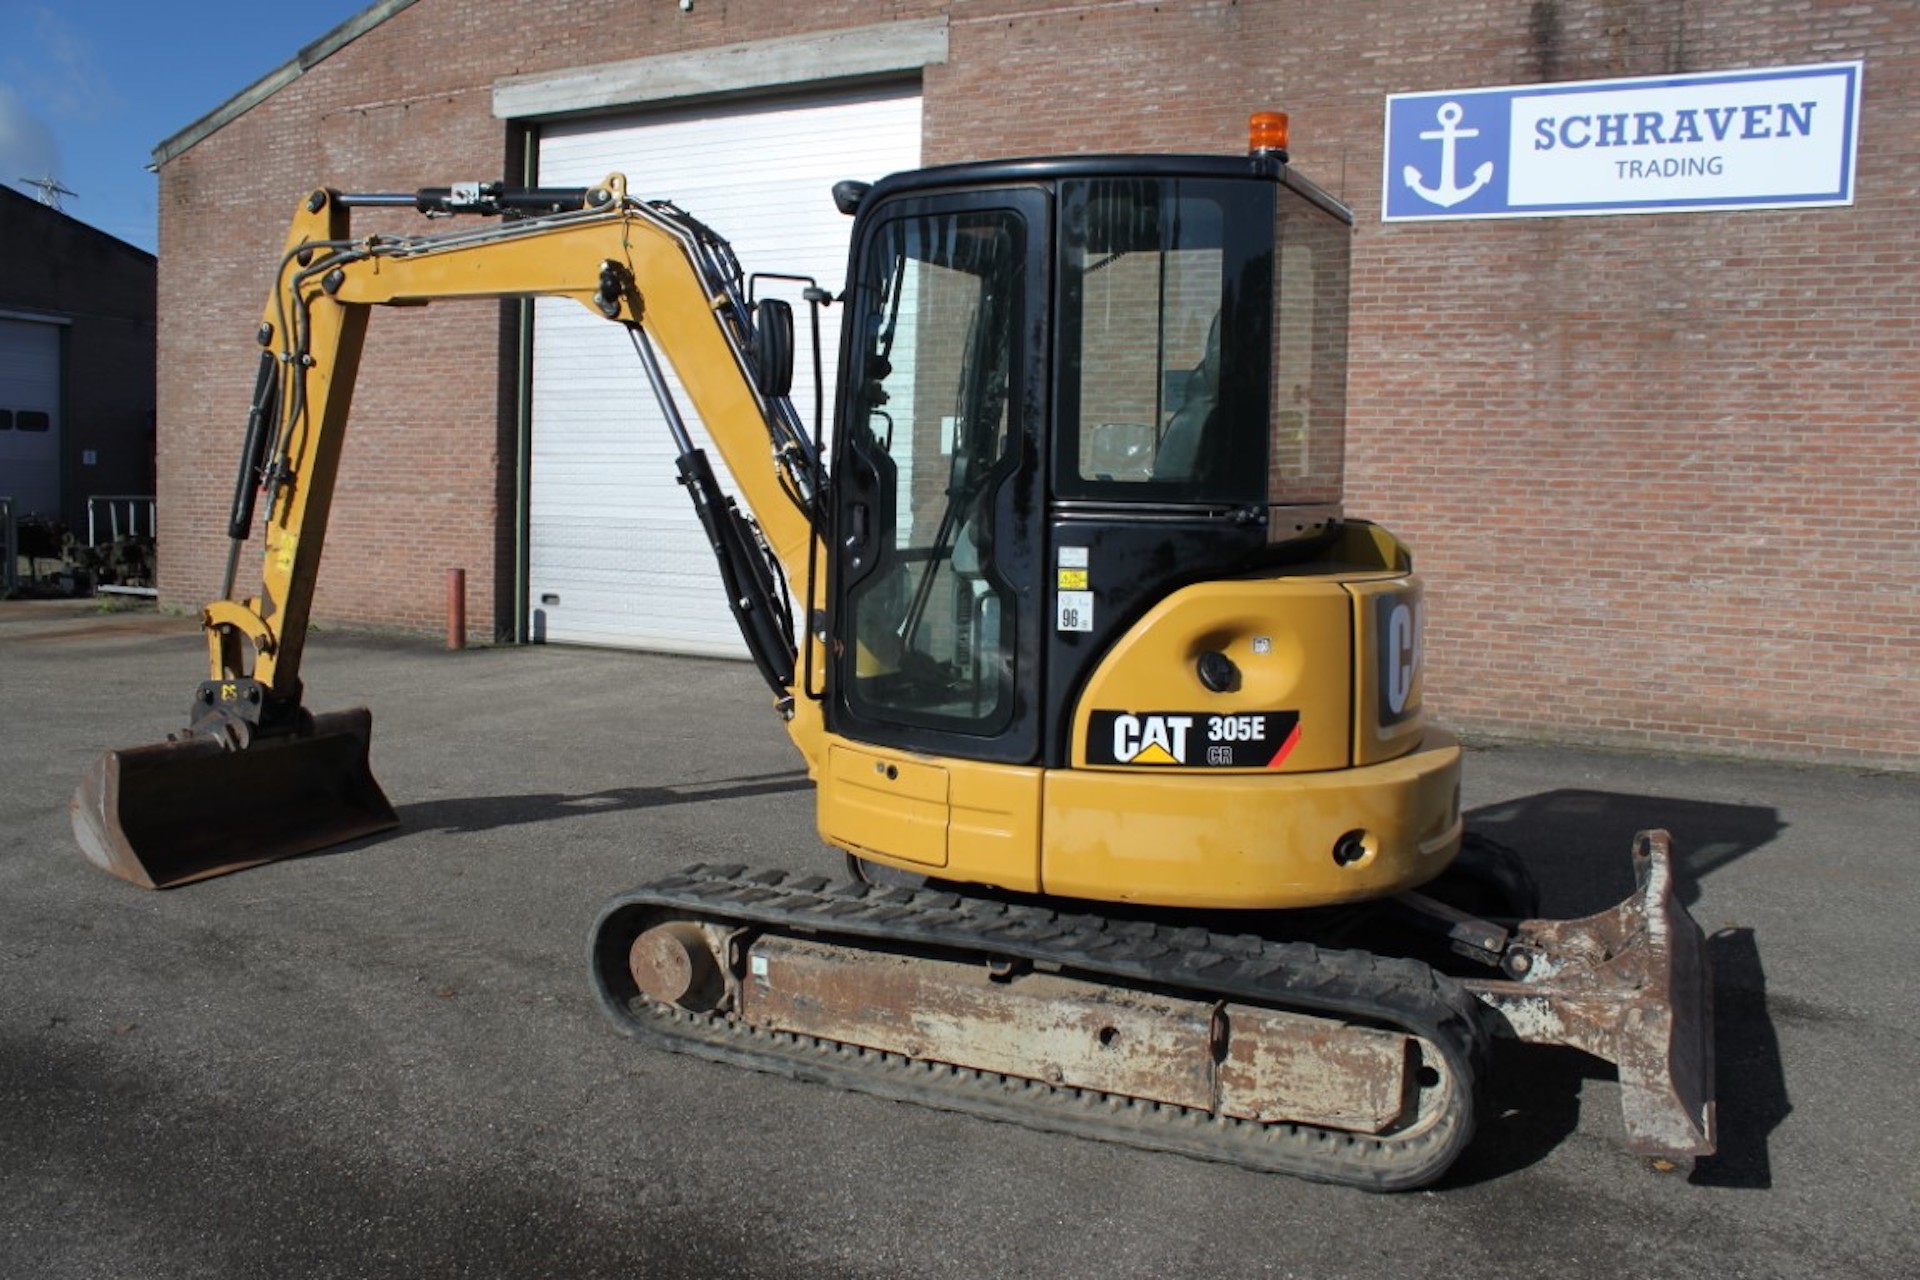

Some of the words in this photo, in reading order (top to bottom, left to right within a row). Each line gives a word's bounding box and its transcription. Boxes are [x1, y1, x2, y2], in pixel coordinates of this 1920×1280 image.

[1535, 102, 1816, 150] SCHRAVEN
[1616, 156, 1723, 180] TRADING
[1062, 608, 1078, 627] 96
[1114, 715, 1193, 764] CAT
[1208, 716, 1265, 742] 305E
[1207, 747, 1233, 765] CR
